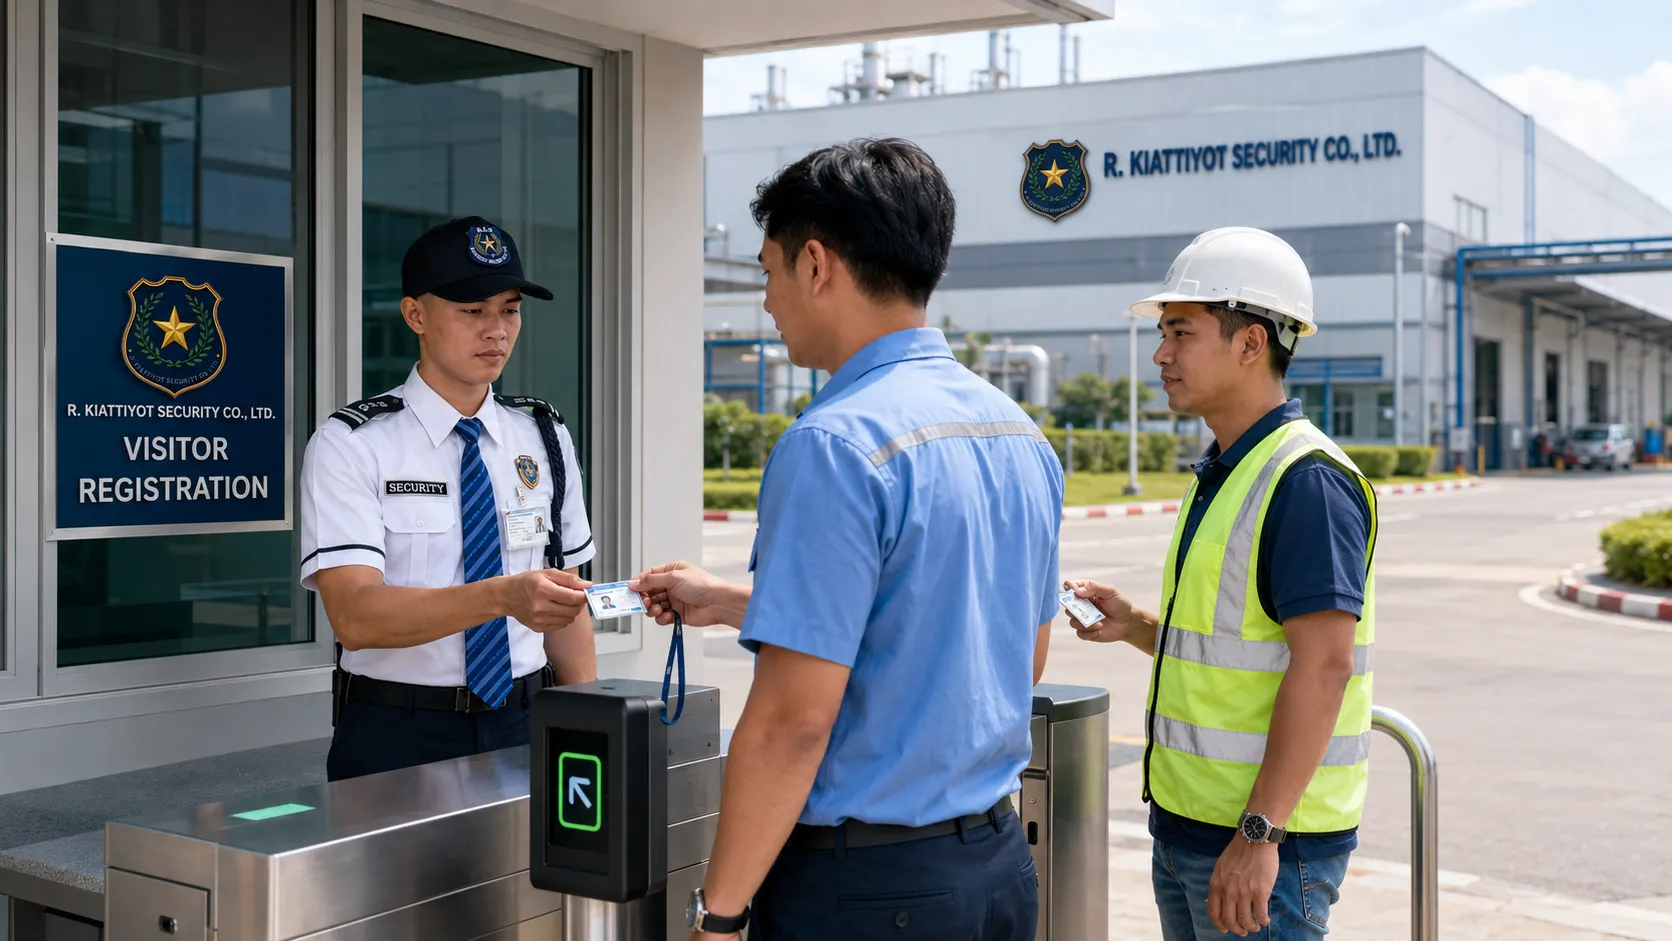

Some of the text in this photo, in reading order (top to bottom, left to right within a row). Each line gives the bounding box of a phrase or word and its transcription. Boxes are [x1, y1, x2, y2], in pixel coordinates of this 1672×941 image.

[1103, 131, 1402, 178] R. KIATTIYOT SECURITY CO., LTD.
[67, 404, 276, 421] R. KIATTIYOT SECURITY CO., LTD.
[123, 436, 229, 461] VISITOR
[79, 475, 268, 504] REGISTRATION
[389, 482, 444, 494] SECURITY
